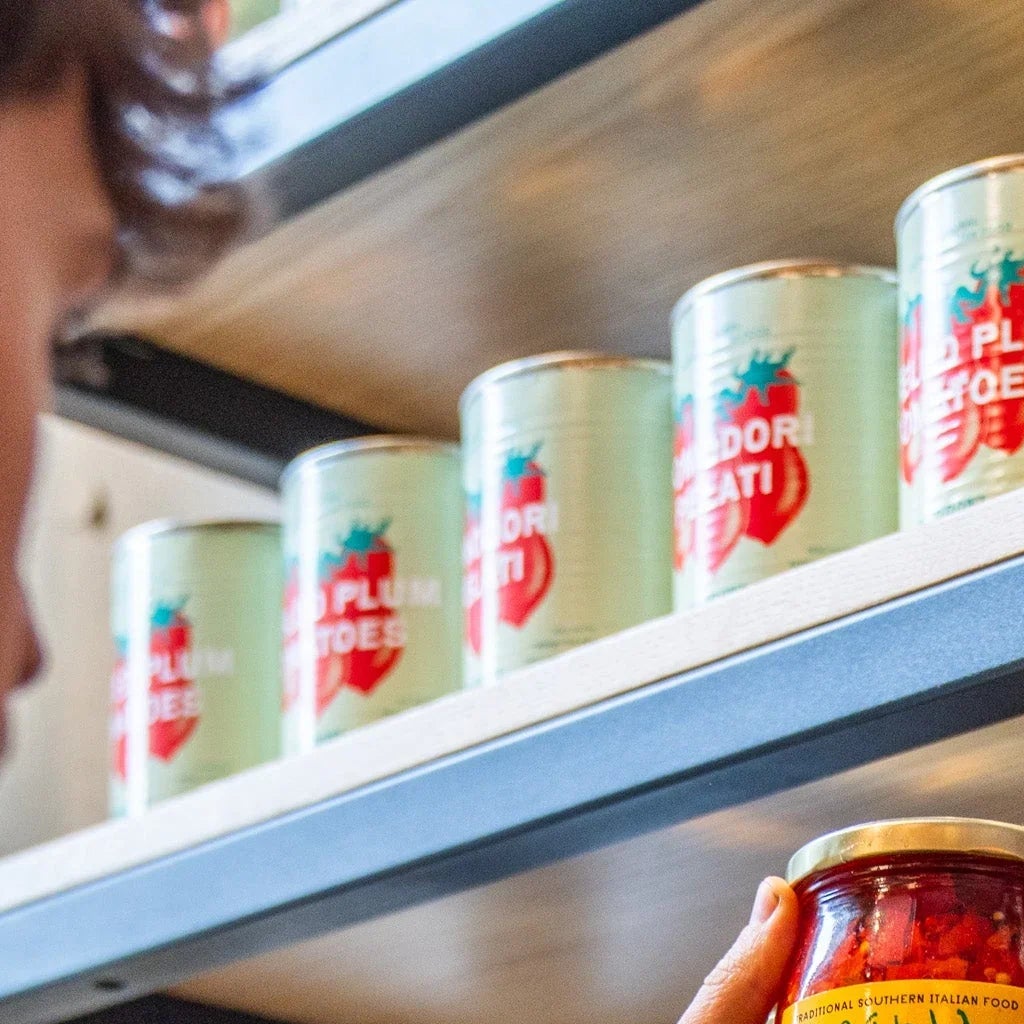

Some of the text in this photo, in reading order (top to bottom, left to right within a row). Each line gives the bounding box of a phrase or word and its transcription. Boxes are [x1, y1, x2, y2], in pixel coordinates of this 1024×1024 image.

[719, 412, 816, 462] DORI
[858, 994, 925, 1008] SOUTHERN
[930, 994, 978, 1006] ITALIAN
[983, 997, 1019, 1011] FOOD
